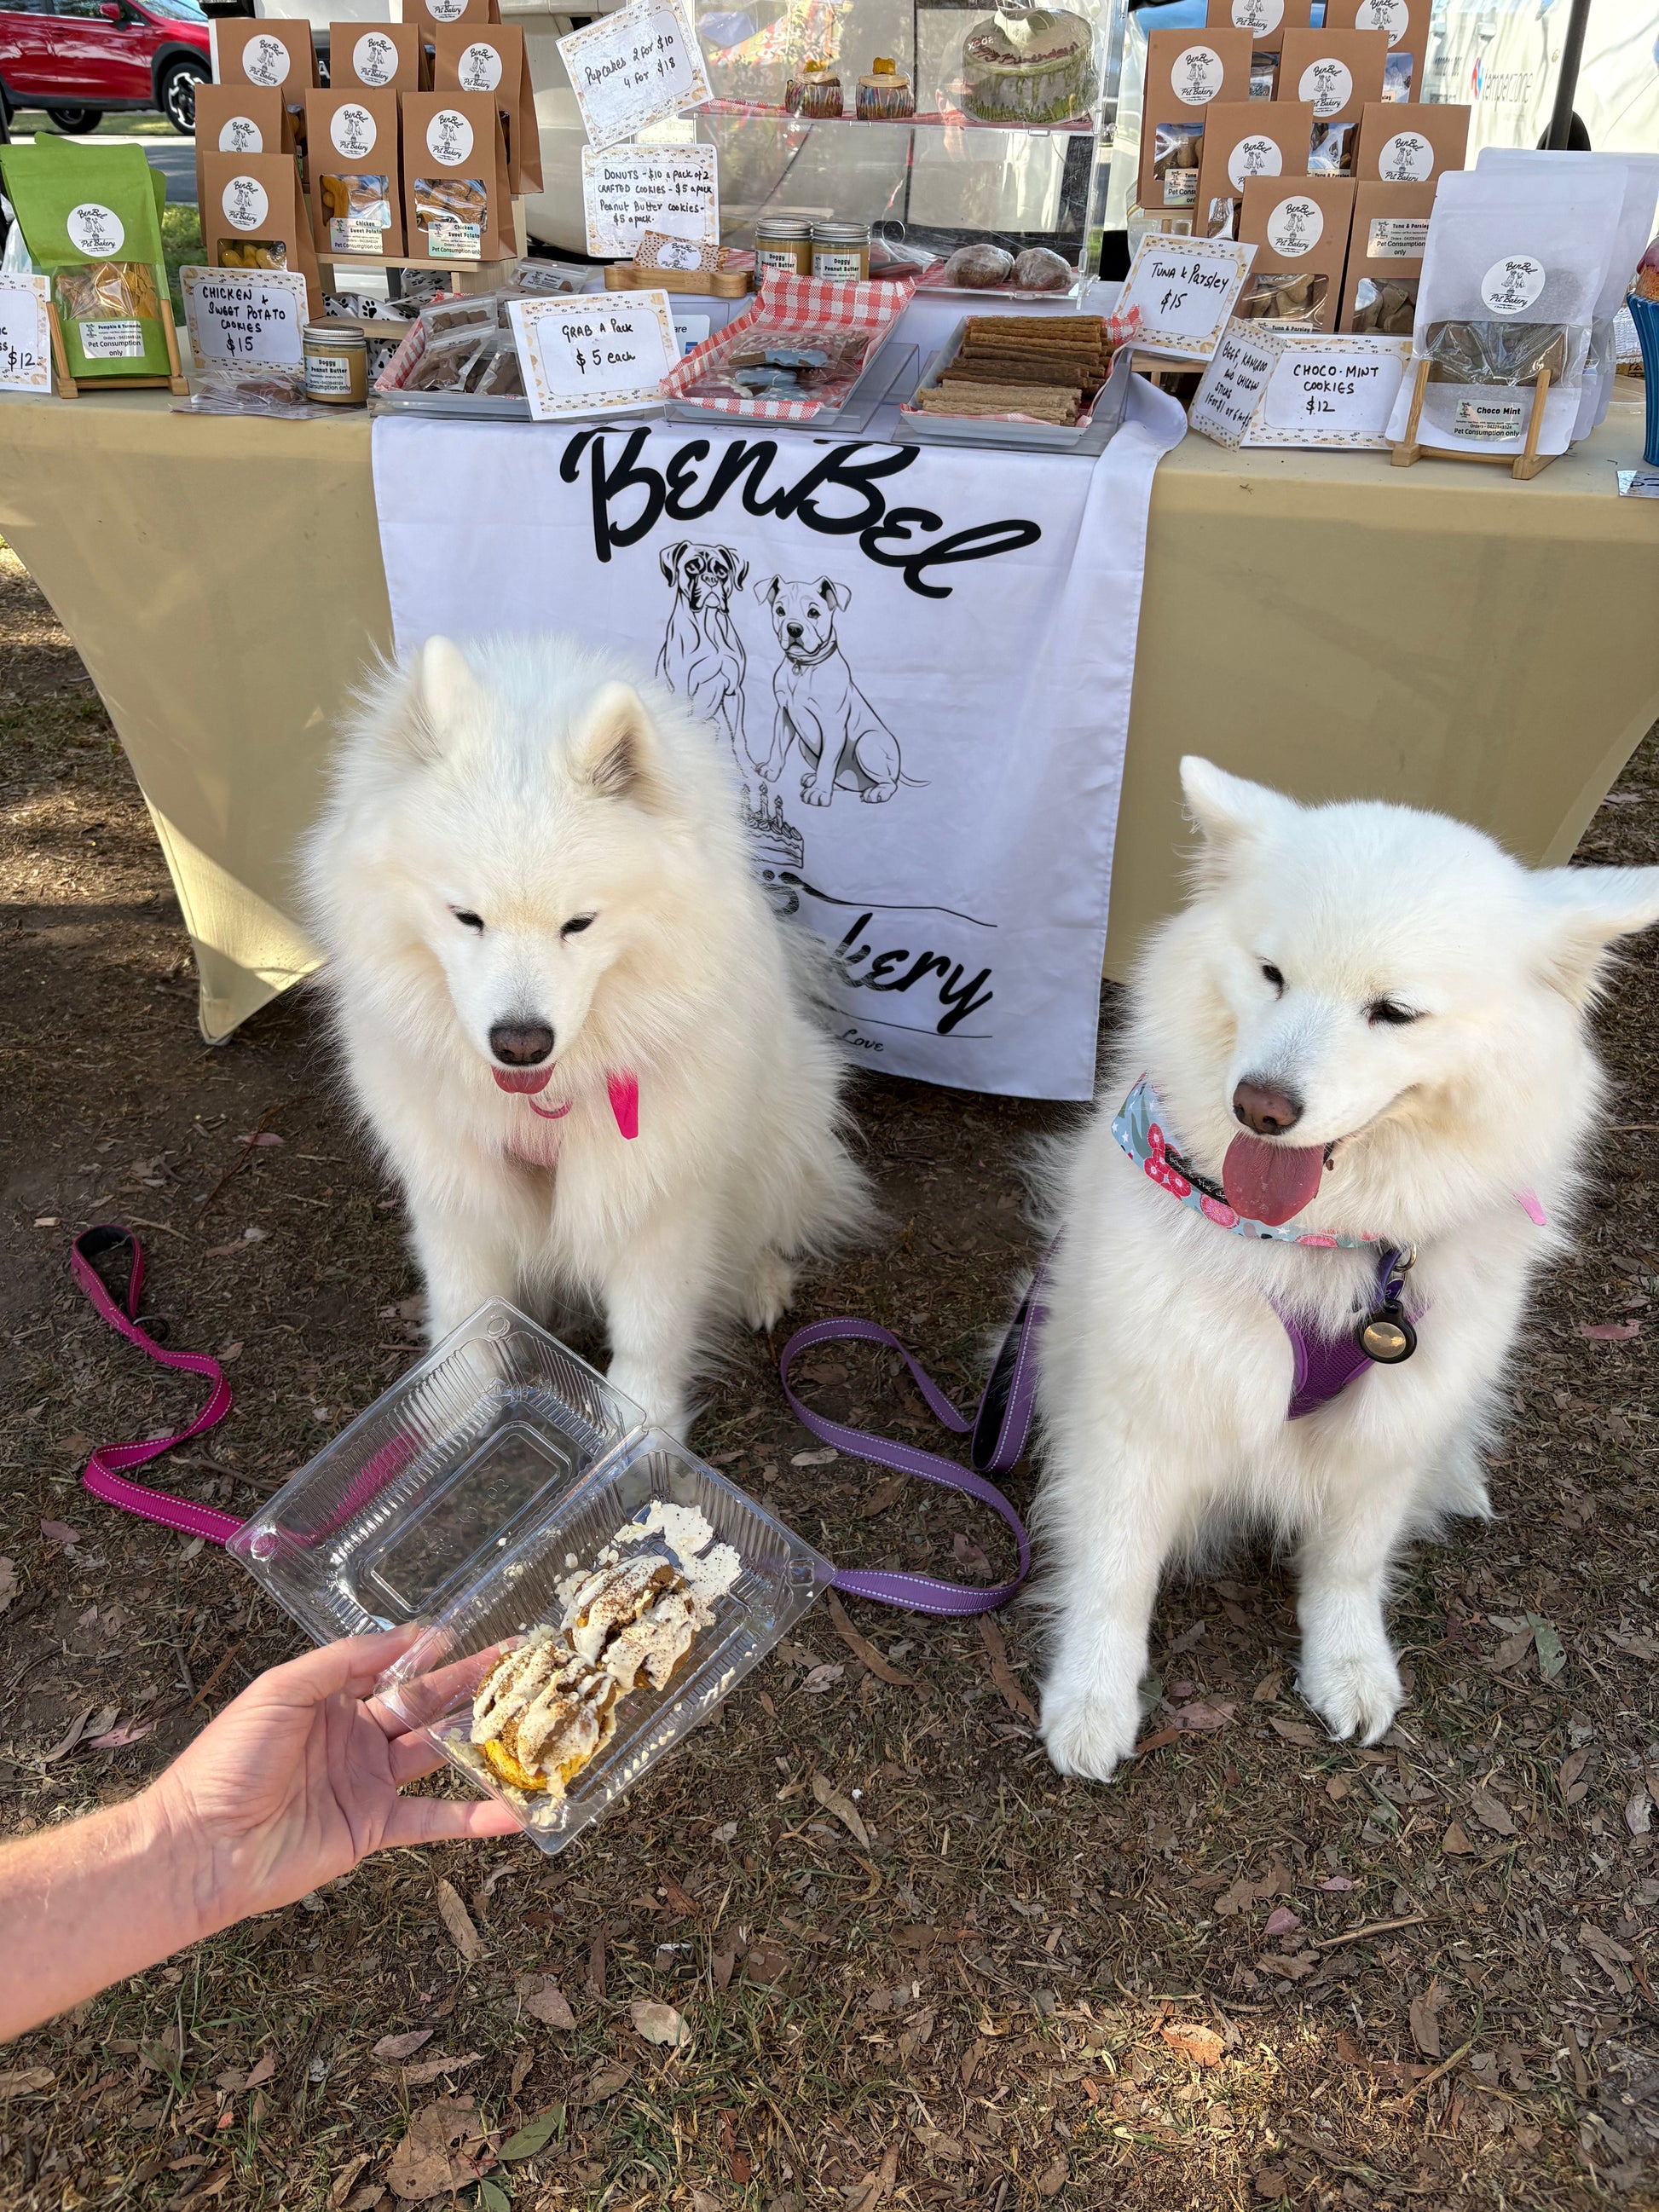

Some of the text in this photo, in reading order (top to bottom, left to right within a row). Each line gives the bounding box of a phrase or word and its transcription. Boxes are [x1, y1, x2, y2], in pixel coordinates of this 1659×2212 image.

[444, 6, 461, 17] Bakery
[1236, 17, 1268, 31] Pet Bakery
[367, 38, 392, 52] BenBel
[470, 48, 494, 61] BenBel
[585, 35, 673, 86] Pupcakes 2 for $10
[1185, 53, 1214, 66] BenBel
[361, 66, 370, 75] Pet
[371, 68, 389, 82] Bakery
[624, 56, 676, 89] 4 for $18
[1313, 64, 1342, 77] BenBel
[463, 77, 490, 90] Pet Bakery
[1193, 88, 1213, 97] Bakery
[1321, 99, 1341, 108] Bakery
[343, 110, 368, 123] BenBel
[438, 114, 464, 128] BenBel
[232, 121, 255, 135] BenBel
[340, 141, 368, 153] Pet Bakery
[433, 144, 462, 157] Pet Bakery
[1243, 141, 1272, 153] BenBel
[1395, 138, 1424, 151] BenBel
[604, 168, 639, 181] DONUTS
[673, 170, 694, 182] pack
[695, 169, 702, 179] of
[702, 170, 709, 180] 2
[1385, 171, 1396, 180] Pet
[598, 184, 631, 193] CRAFTED
[635, 184, 666, 194] COOKIES
[696, 185, 713, 197] pack
[600, 199, 662, 212] Peanut Butter
[1286, 204, 1315, 217] BenBel
[78, 209, 107, 219] BenBel
[94, 239, 115, 248] Bakery
[1275, 239, 1309, 251] Pet Bakery
[1506, 261, 1538, 274] BenBel
[1188, 263, 1230, 294] Parsley
[202, 286, 252, 301] CHICKEN
[1160, 289, 1188, 314] $15
[1490, 294, 1529, 307] Pet Bakery
[247, 305, 286, 321] POTATO
[221, 319, 262, 333] COOKIES
[562, 318, 633, 343] GRAB A Pack
[226, 333, 253, 357] $15
[7, 345, 36, 373] $12
[607, 350, 636, 362] each
[1304, 380, 1355, 394] COOKIES
[1306, 396, 1335, 415] $12
[1465, 429, 1505, 437] Consumption
[840, 1029, 884, 1052] Love
